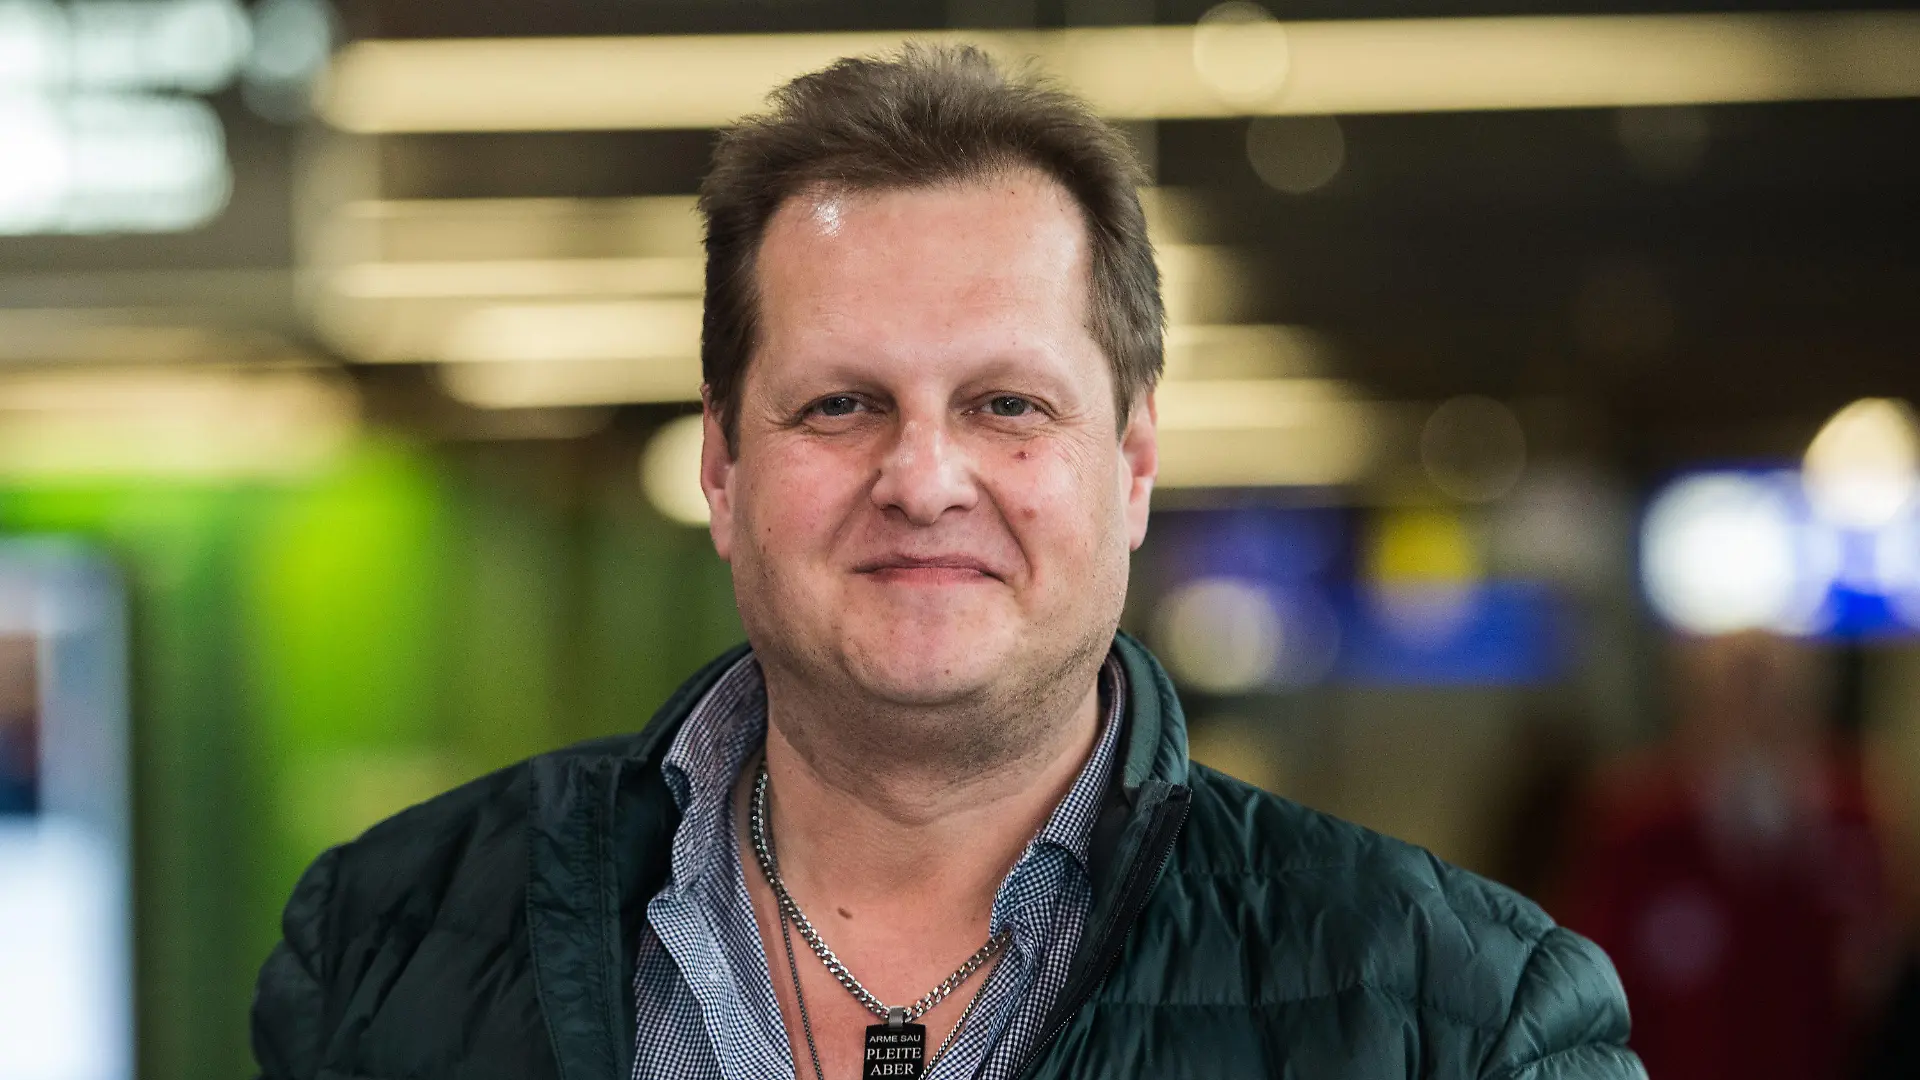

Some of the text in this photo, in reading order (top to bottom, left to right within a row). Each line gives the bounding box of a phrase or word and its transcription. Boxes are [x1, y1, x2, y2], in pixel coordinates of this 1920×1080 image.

[869, 1034, 921, 1043] ARME SAU
[866, 1047, 922, 1060] PLEITE
[870, 1063, 914, 1076] ABER
